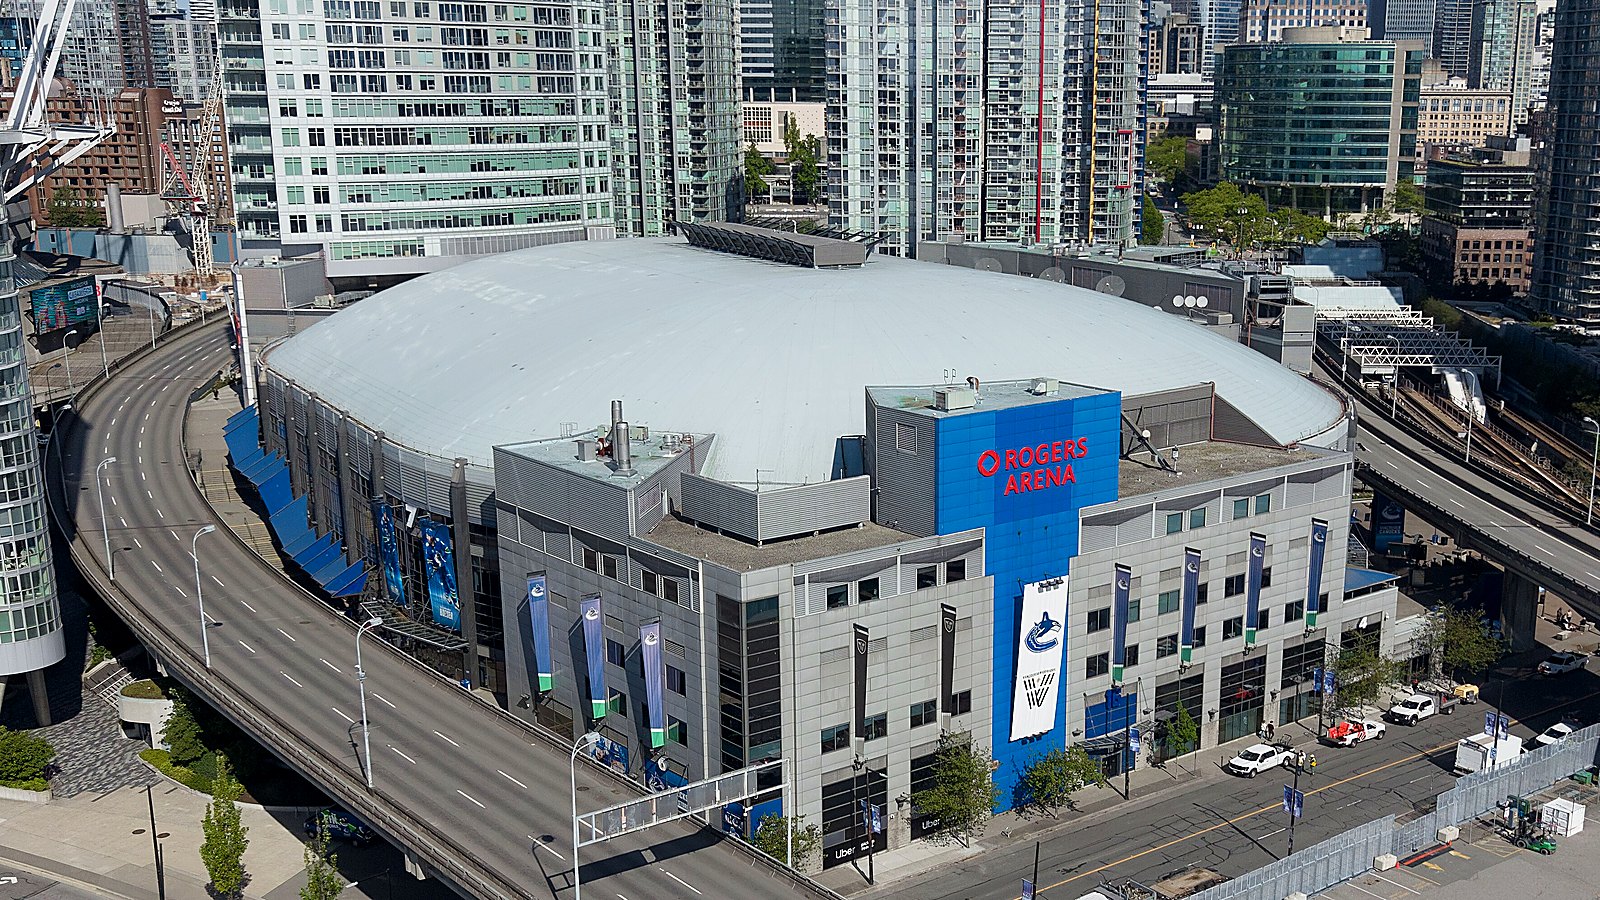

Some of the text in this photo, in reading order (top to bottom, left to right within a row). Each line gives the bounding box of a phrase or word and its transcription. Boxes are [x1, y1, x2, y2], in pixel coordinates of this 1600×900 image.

[1005, 437, 1088, 470] ROGERS
[1004, 463, 1076, 496] ARENA
[405, 504, 417, 528] 7
[1358, 616, 1368, 629] 4
[922, 818, 941, 830] Uber
[835, 846, 856, 859] Uber
